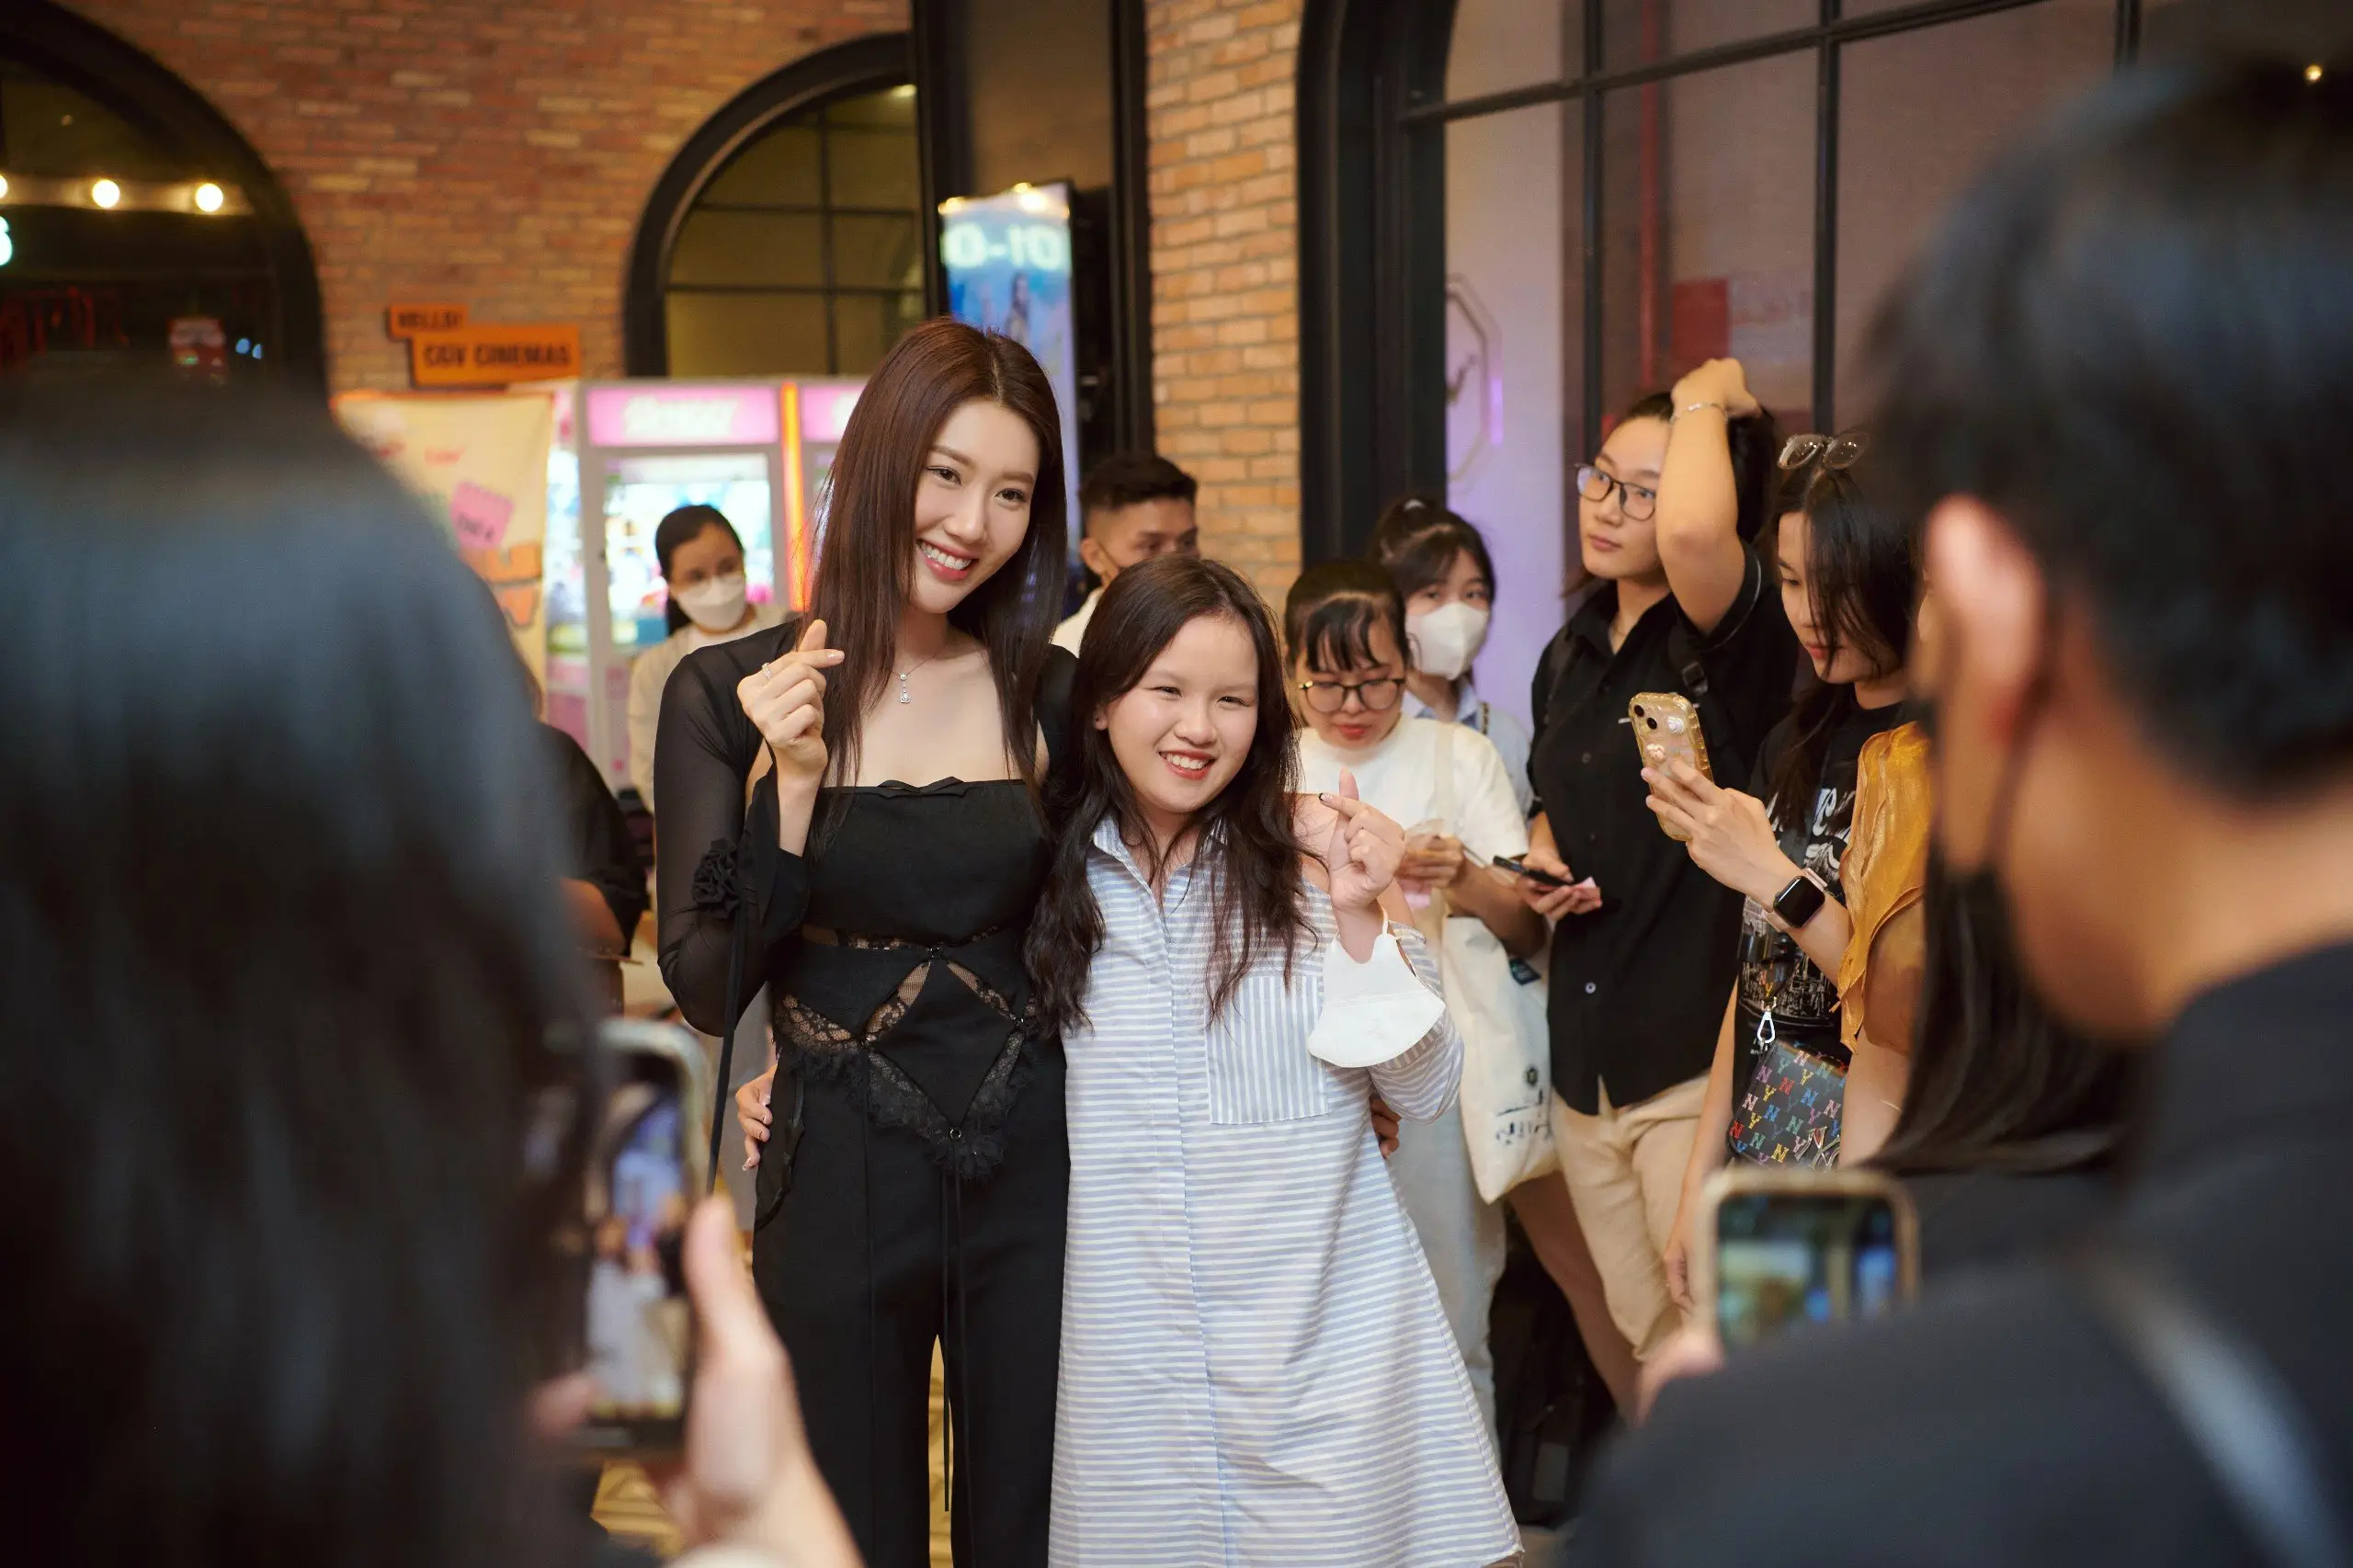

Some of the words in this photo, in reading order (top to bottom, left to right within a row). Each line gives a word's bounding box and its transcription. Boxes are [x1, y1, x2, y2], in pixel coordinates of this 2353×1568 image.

[1800, 1068, 1814, 1085] Y
[1763, 1085, 1777, 1102] Y
[1779, 1076, 1795, 1096] N
[1801, 1087, 1819, 1107] N
[1824, 1099, 1841, 1119] N
[1742, 1093, 1758, 1111] N
[1764, 1104, 1780, 1121] N
[1786, 1115, 1803, 1134] N
[1748, 1112, 1762, 1130] Y
[1729, 1120, 1745, 1140] N
[1771, 1143, 1790, 1163] N
